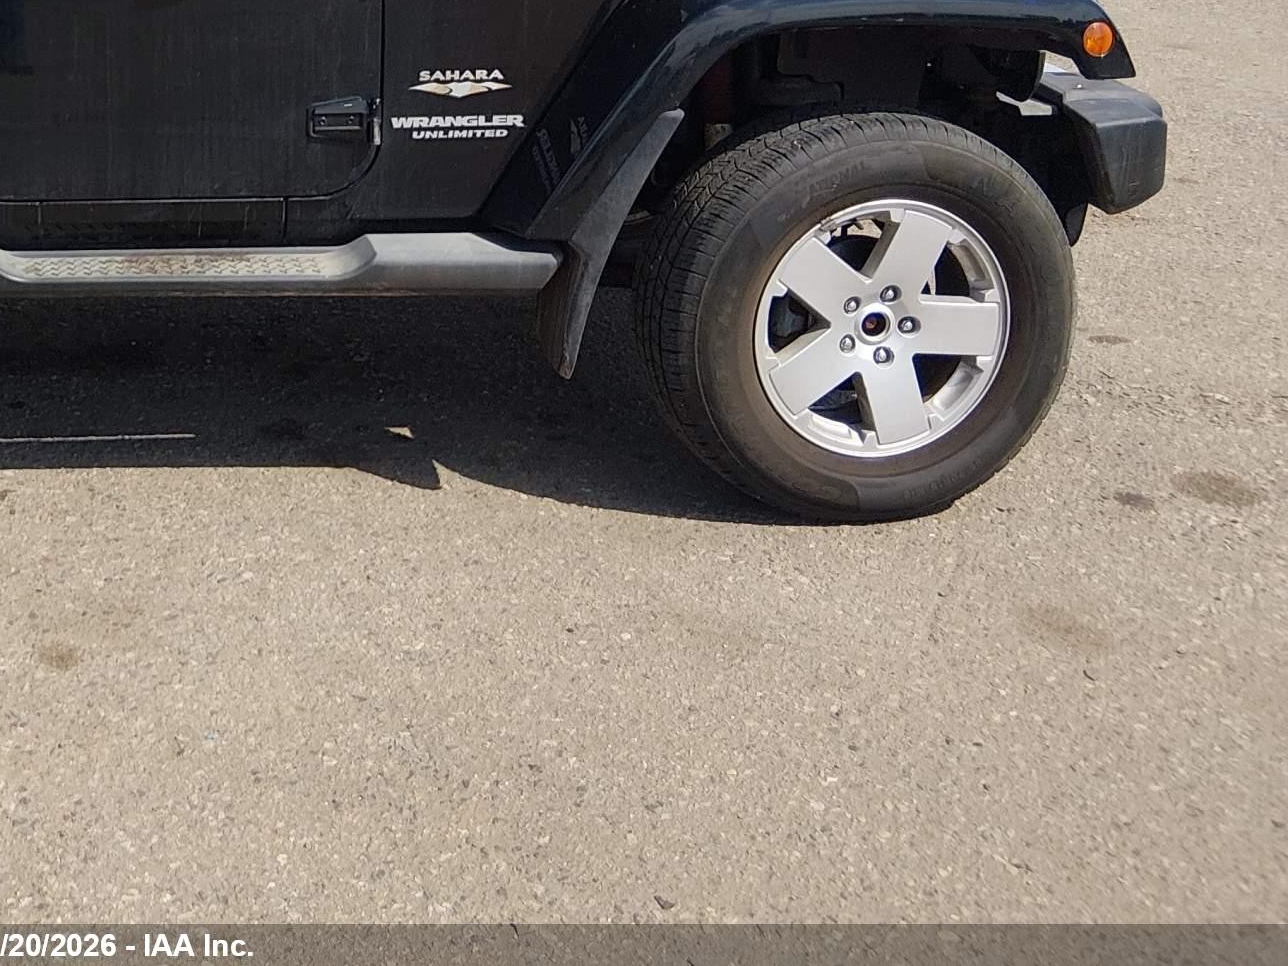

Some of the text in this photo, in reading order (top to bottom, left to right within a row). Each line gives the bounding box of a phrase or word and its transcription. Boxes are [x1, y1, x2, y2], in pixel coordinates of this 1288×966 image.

[418, 69, 505, 81] SAHARA
[390, 114, 526, 129] WRANGLER
[411, 129, 510, 140] UNLIMITED
